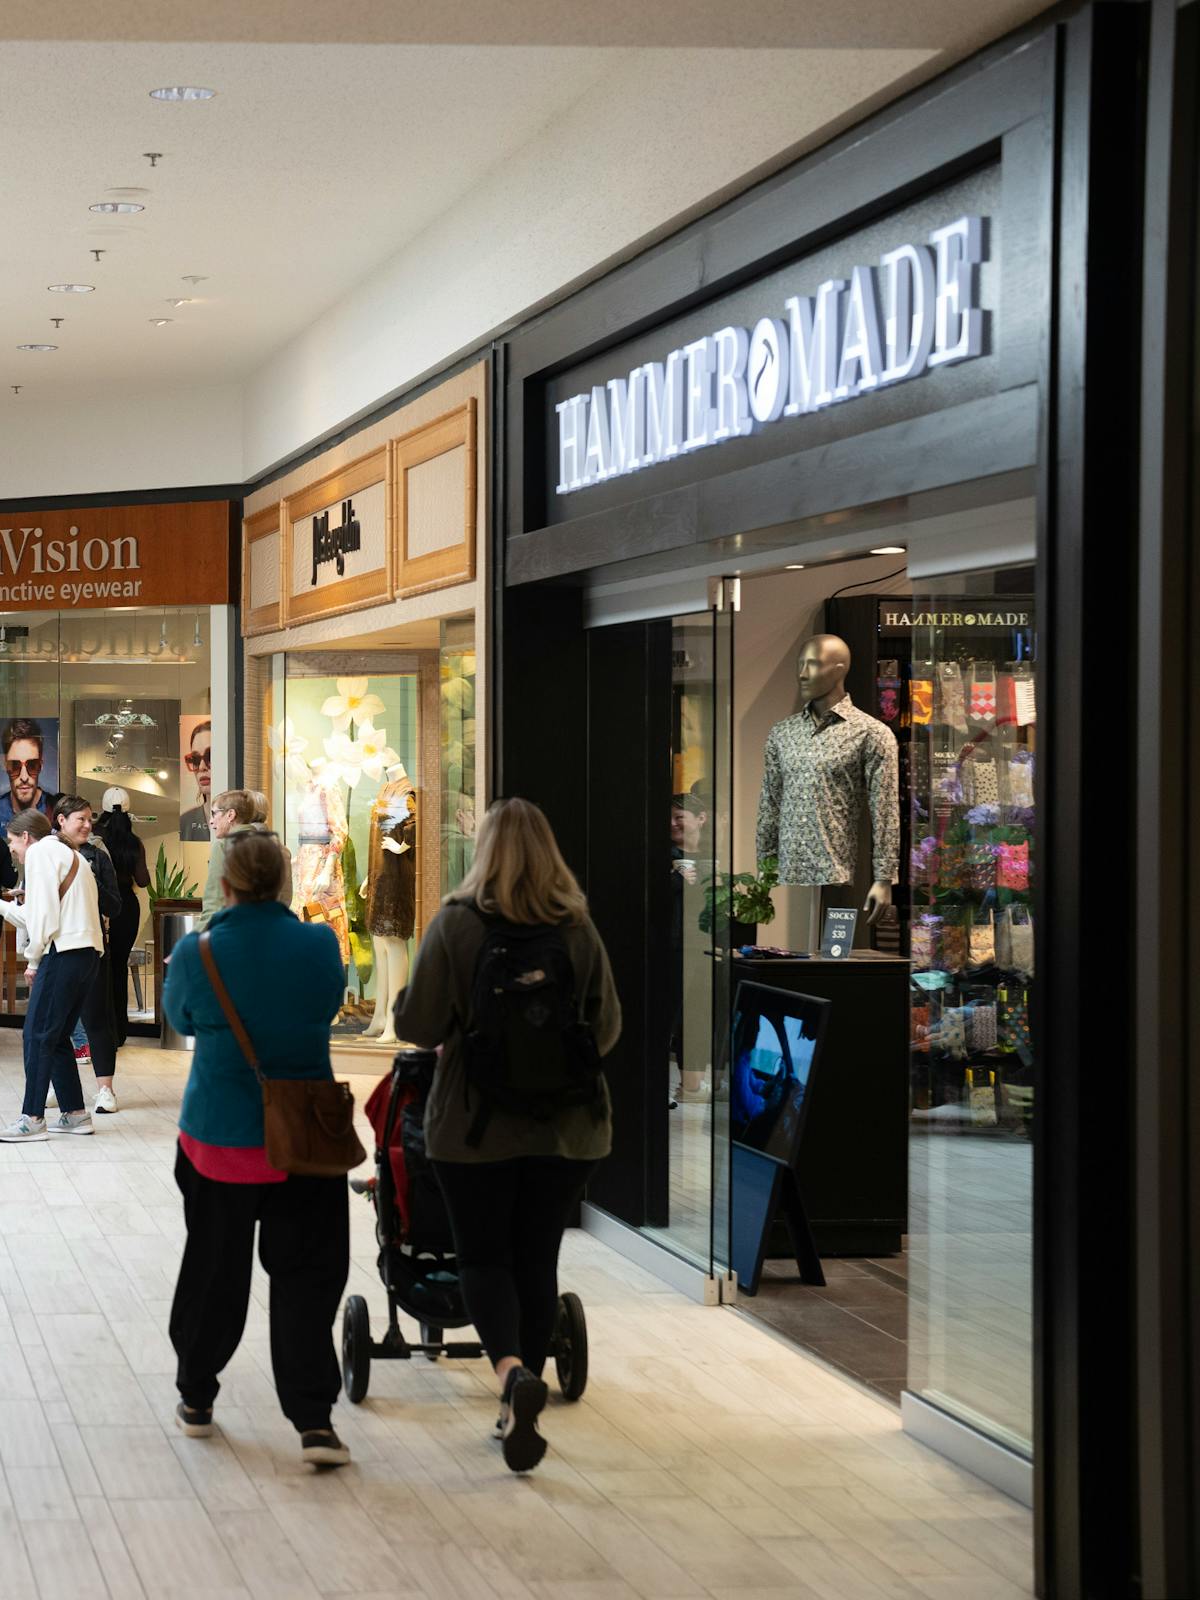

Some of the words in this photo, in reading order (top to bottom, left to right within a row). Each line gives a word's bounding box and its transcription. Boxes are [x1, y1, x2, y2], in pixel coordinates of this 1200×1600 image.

[60, 580, 142, 605] eyewear
[828, 911, 855, 920] SOCKS
[831, 930, 847, 939] $30
